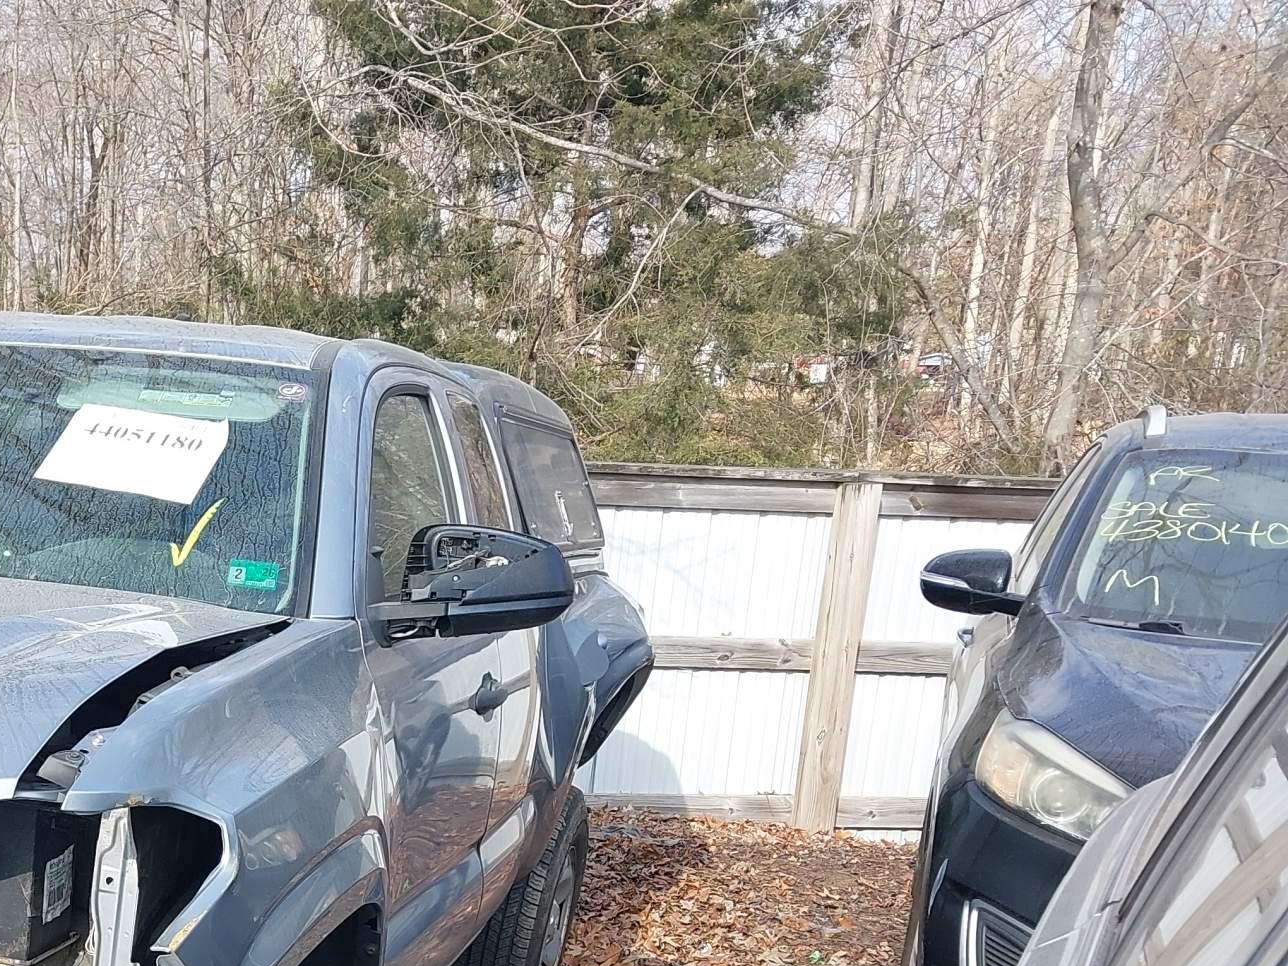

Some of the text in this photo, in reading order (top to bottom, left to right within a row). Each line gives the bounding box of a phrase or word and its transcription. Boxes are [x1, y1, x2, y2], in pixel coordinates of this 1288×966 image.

[83, 422, 203, 452] 44051180
[1101, 500, 1216, 520] SALE
[234, 568, 243, 580] 2
[1104, 568, 1160, 606] M
